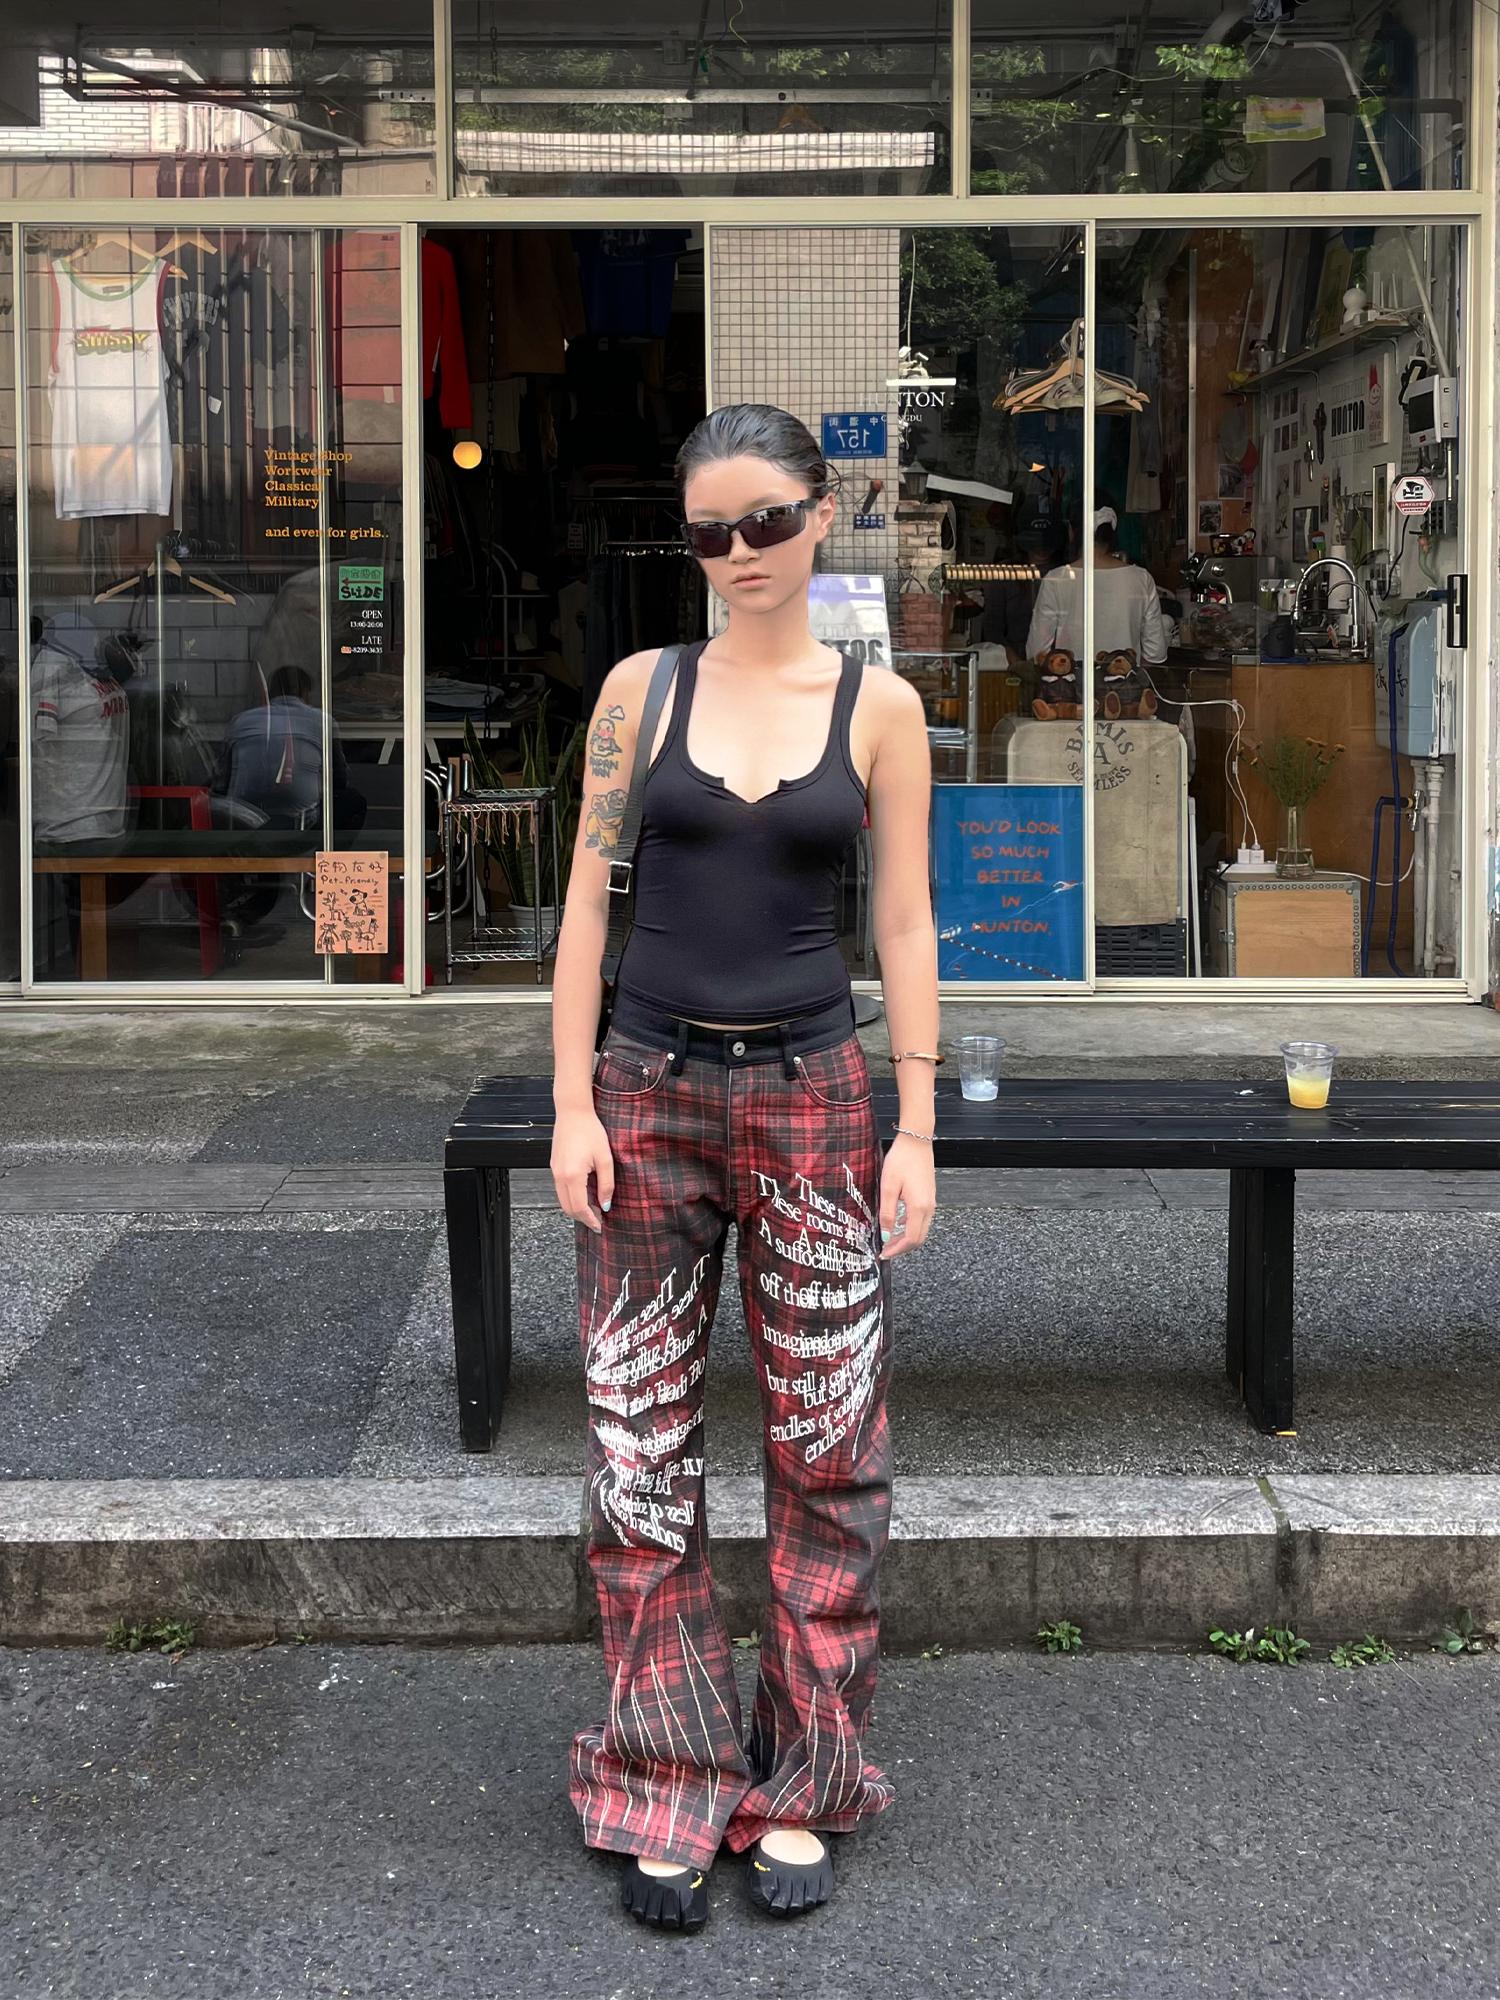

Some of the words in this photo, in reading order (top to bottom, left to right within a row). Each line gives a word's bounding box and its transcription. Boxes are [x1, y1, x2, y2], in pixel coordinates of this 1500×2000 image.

[859, 391, 946, 407] HUNTON
[881, 414, 922, 422] CNGDU
[264, 450, 316, 463] Vintage
[319, 450, 353, 463] Shop
[265, 465, 333, 476] Workwear
[265, 496, 319, 509] Military
[265, 527, 290, 538] and
[293, 528, 324, 538] even
[327, 527, 347, 538] for
[361, 609, 383, 619] OPEN
[361, 635, 383, 645] LATE
[1067, 761, 1131, 791] SELESS
[957, 821, 1012, 836] YOU'D
[1016, 821, 1062, 835] LOOK
[971, 845, 994, 859] SO
[998, 845, 1049, 858] MUCH
[318, 860, 384, 874] 宠物友好
[977, 869, 1044, 883] BETTER
[1002, 894, 1021, 908] IN
[795, 1172, 837, 1218] These
[751, 1169, 803, 1222] These
[806, 1212, 844, 1238] rooms
[759, 1217, 773, 1247] A
[799, 1227, 813, 1254] A
[760, 1272, 783, 1300] off
[765, 1364, 789, 1395] but
[791, 1371, 816, 1396] still
[770, 1414, 816, 1442] endless
[818, 1404, 834, 1428] of
[805, 1421, 847, 1464] endless
